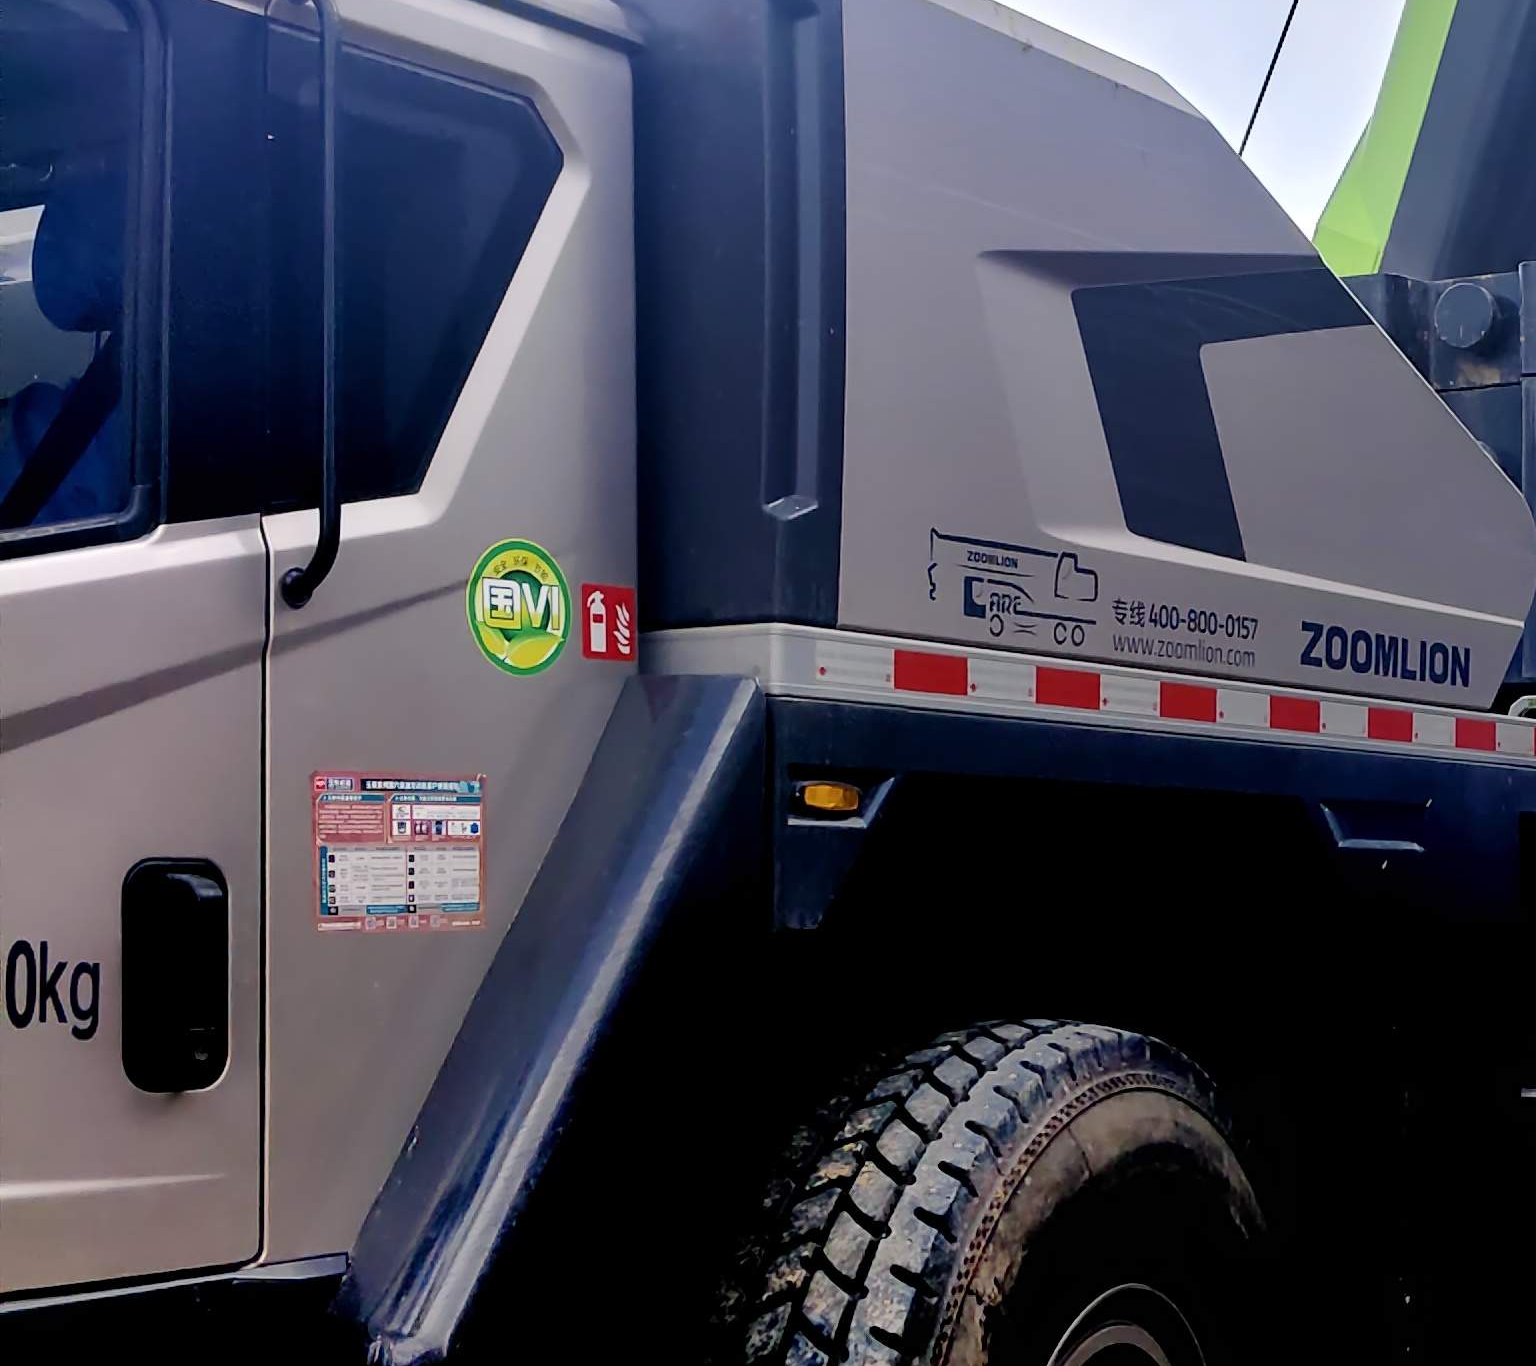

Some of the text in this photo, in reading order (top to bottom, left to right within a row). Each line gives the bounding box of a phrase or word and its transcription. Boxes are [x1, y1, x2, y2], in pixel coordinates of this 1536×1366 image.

[1149, 603, 1259, 641] 400-800-0157
[1112, 634, 1257, 668] www.zoomlion.com
[1300, 620, 1471, 688] ZOOMLION
[6, 940, 100, 1041] 0kg
